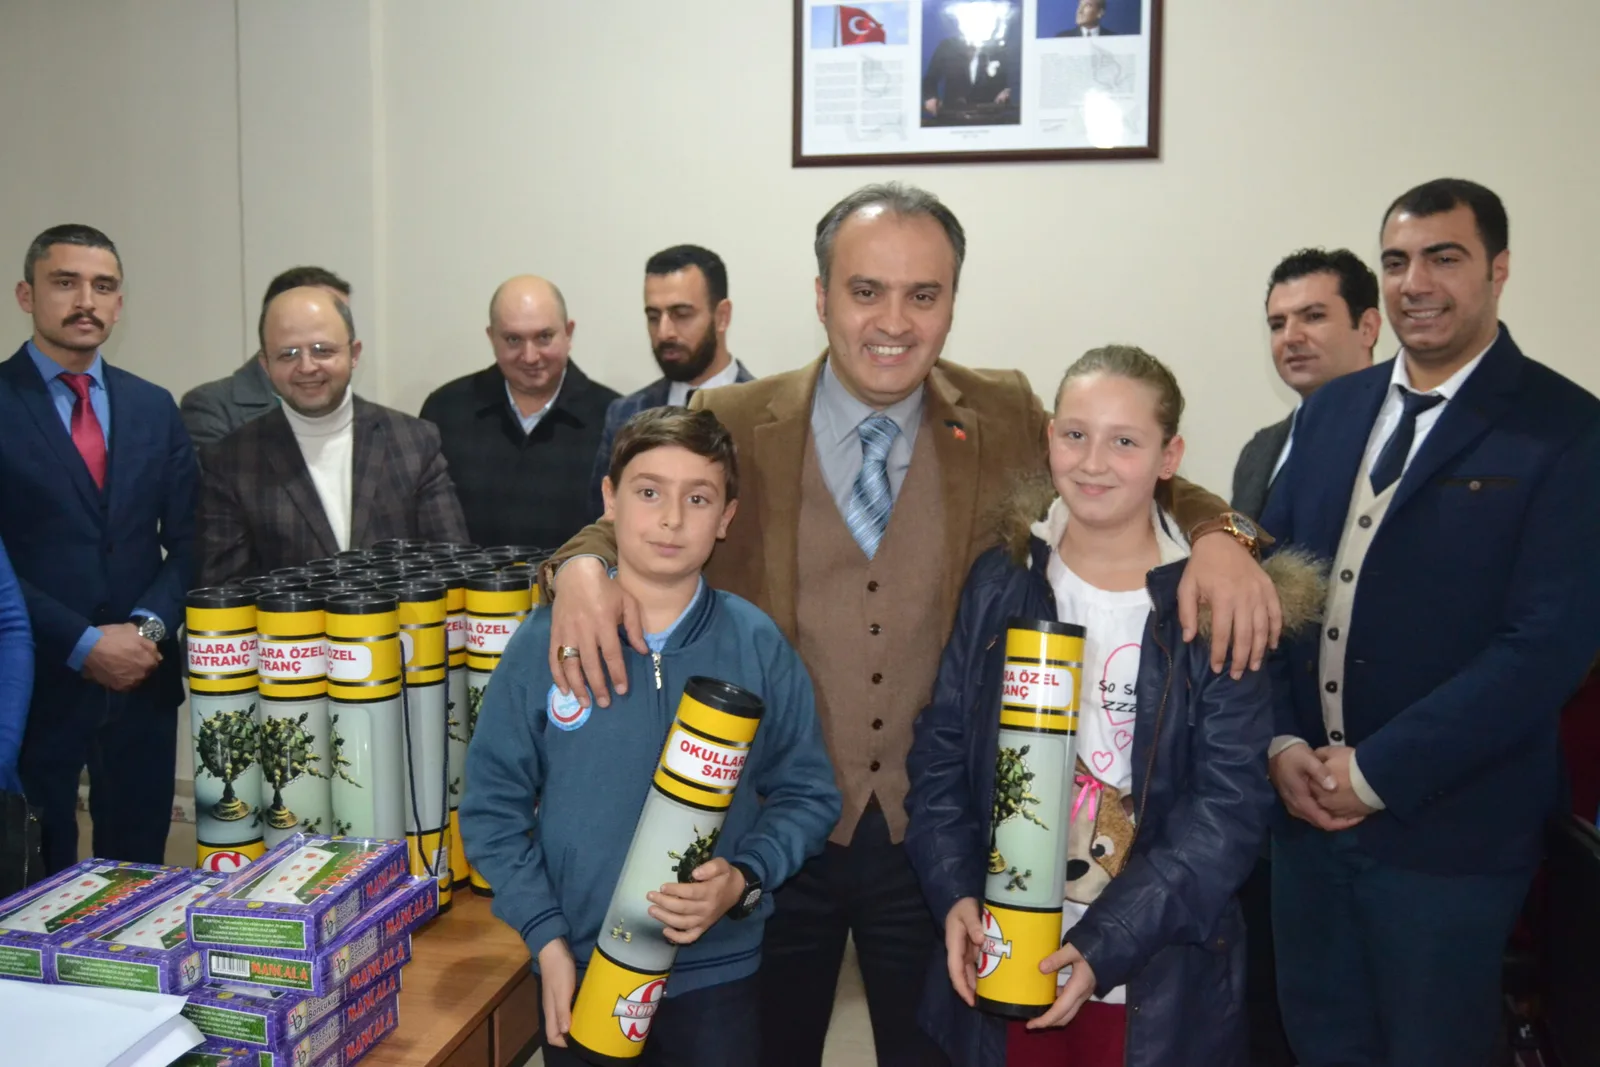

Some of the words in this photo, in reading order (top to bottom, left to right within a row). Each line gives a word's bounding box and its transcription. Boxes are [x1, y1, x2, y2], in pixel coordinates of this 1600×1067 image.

[446, 621, 464, 632] ZEL
[476, 622, 509, 634] ÖZEL
[289, 646, 325, 659] ÖZEL
[327, 647, 356, 661] ÖZEL
[190, 653, 250, 667] SATRANÇ
[1019, 669, 1060, 687] ÖZEL
[1002, 684, 1029, 700] ANÇ
[1098, 680, 1116, 693] SO
[1123, 683, 1137, 696] S
